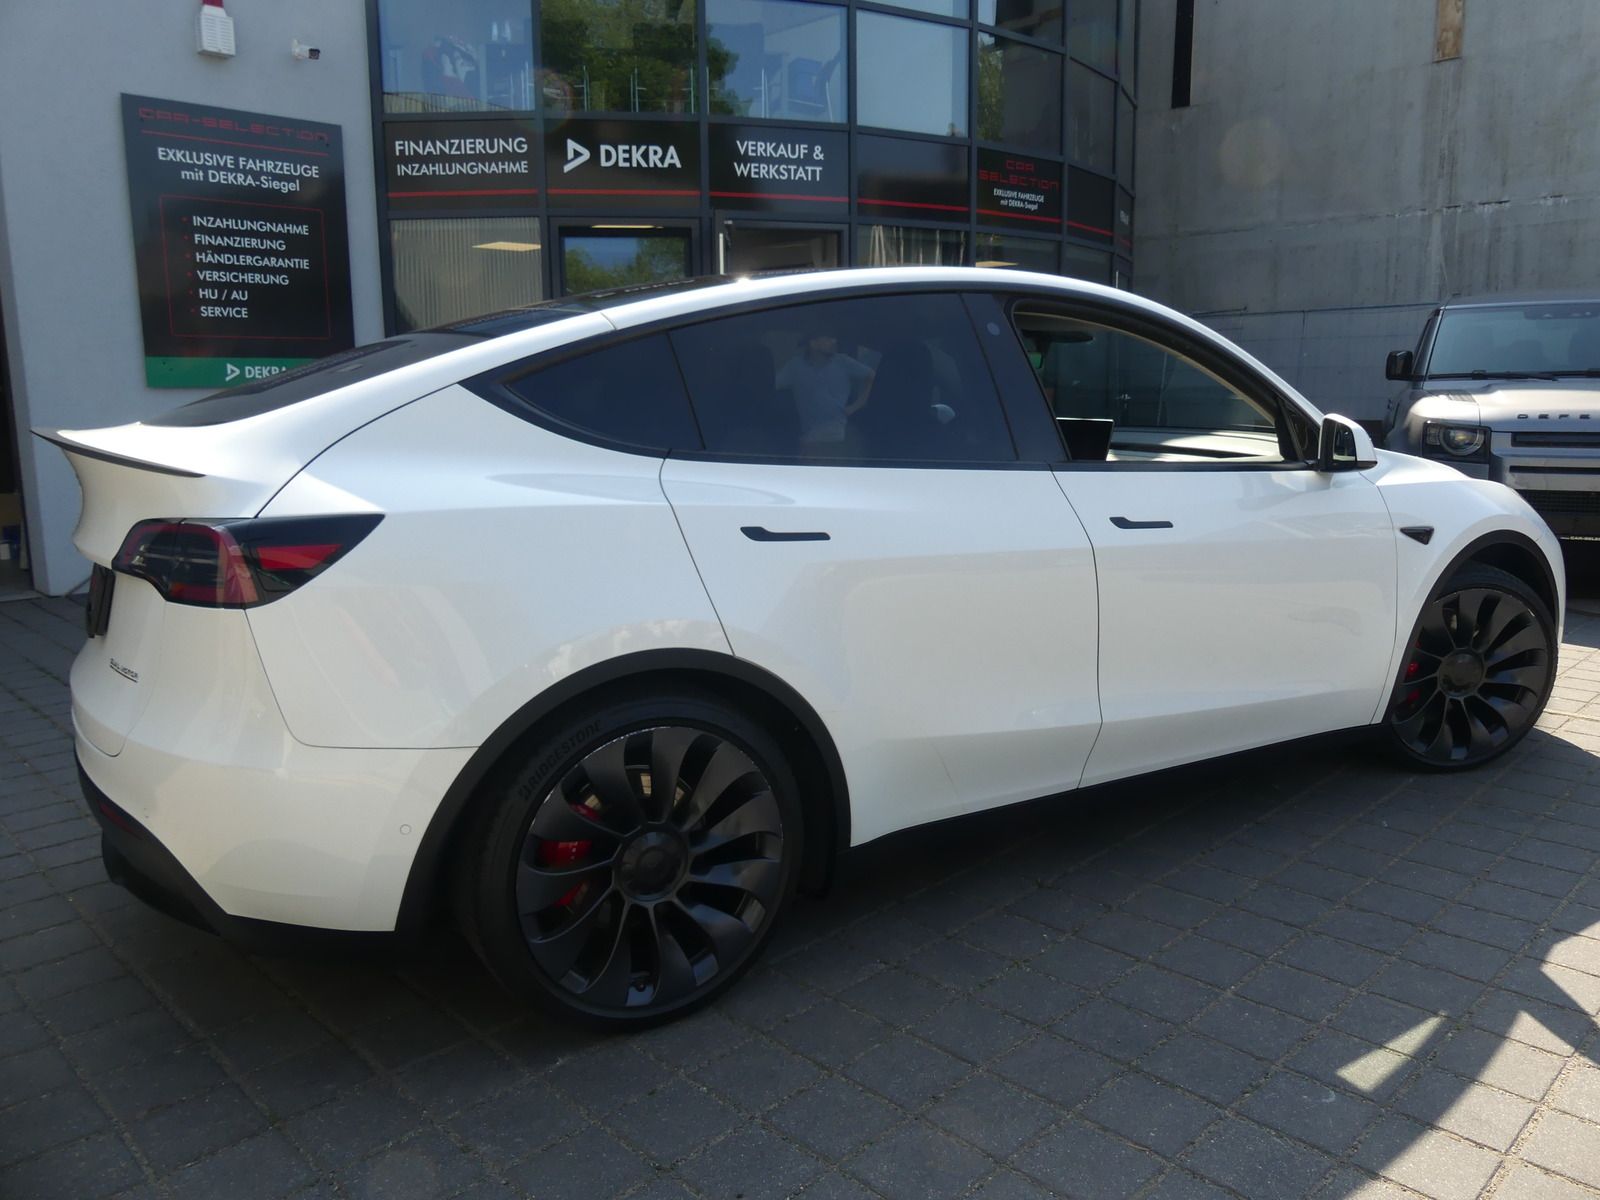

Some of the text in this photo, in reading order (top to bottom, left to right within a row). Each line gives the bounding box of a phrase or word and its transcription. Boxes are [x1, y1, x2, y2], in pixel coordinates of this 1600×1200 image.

[138, 107, 329, 141] CAR-SELECTION
[395, 137, 528, 156] FINANZIERUNG
[736, 140, 824, 161] VERKAUF &
[157, 147, 320, 179] EXKLUSIVE FAHRZEUGE
[600, 144, 682, 169] DEKRA
[1006, 160, 1034, 171] CAR
[397, 160, 528, 176] INZAHLUNGNAHME
[733, 162, 823, 182] WERKSTATT
[181, 169, 301, 193] mit DEKRA-Siegel
[979, 170, 1059, 189] SELECTION
[993, 188, 1044, 203] EXKLUSIVE FAHRZEUGE
[192, 215, 310, 236] INZAHLUNGNAHME
[194, 234, 287, 251] FINANZIERUNG
[195, 251, 310, 270] HÄNDLERGARANTIE
[197, 270, 290, 286] VERSICHERUNG
[198, 288, 249, 301] HU / AU
[200, 306, 249, 318] SERVICE
